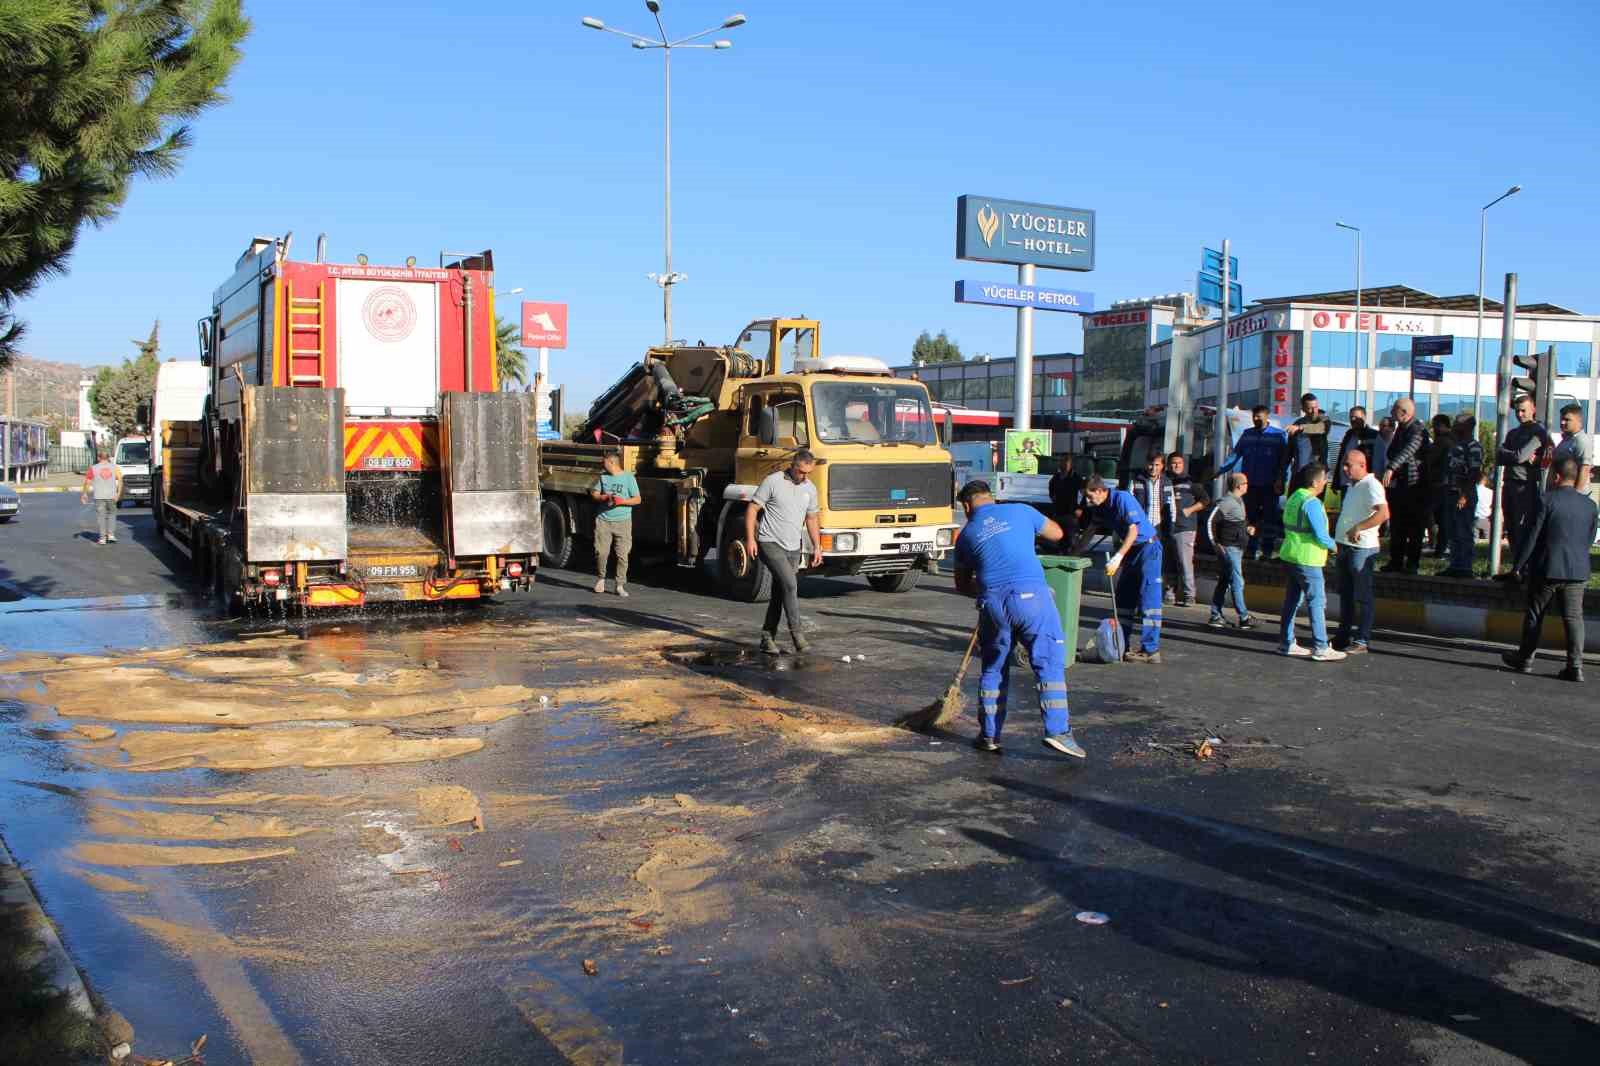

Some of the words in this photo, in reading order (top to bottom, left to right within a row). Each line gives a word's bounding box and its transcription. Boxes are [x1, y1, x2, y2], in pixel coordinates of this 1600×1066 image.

[1008, 212, 1088, 238] YÜCELER
[1024, 238, 1073, 255] HOTEL
[982, 284, 1034, 302] YÜCELER
[1038, 291, 1080, 306] PETROL
[1313, 310, 1390, 331] OTEL
[900, 543, 910, 553] 09
[371, 566, 382, 576] 09
